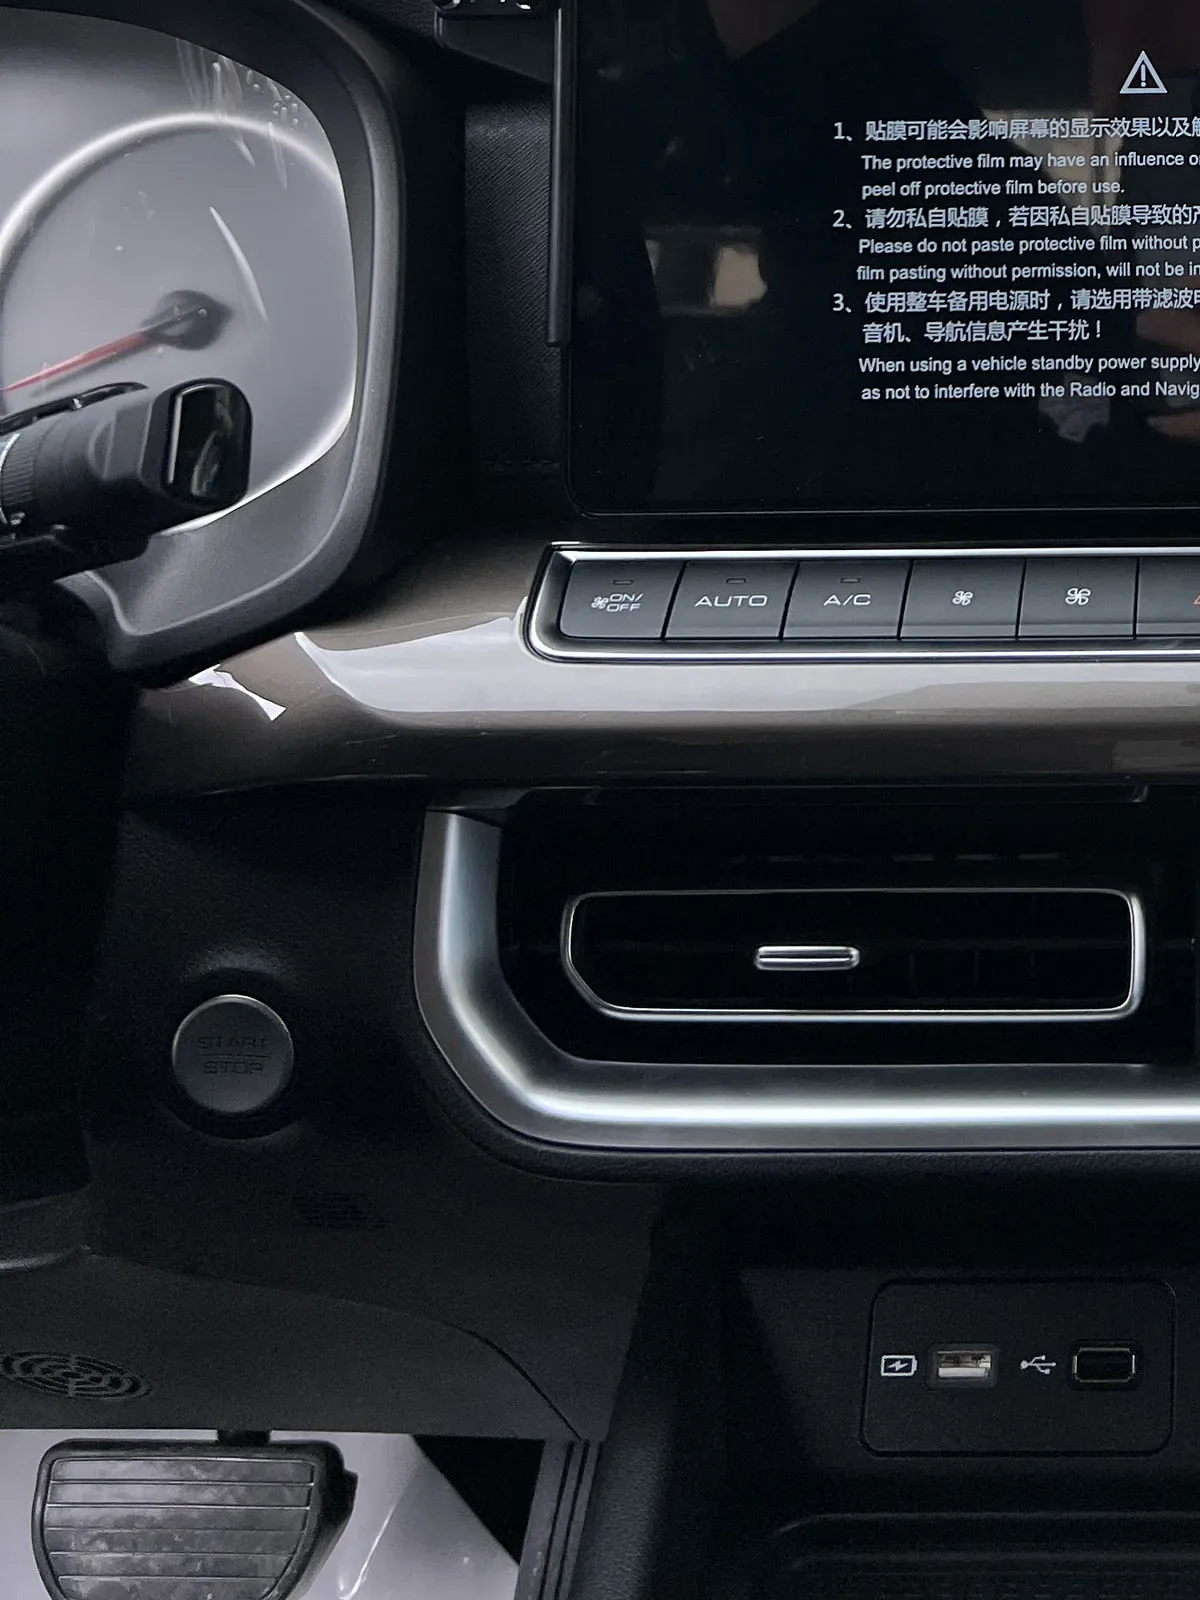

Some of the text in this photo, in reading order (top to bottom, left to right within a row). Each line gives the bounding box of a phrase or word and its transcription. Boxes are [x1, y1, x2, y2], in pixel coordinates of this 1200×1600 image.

[860, 153, 893, 170] The
[895, 153, 974, 173] protective
[976, 152, 1006, 169] film
[1008, 155, 1044, 172] may
[1047, 152, 1086, 168] have
[1089, 150, 1111, 167] an
[1114, 151, 1185, 168] influence
[861, 178, 1125, 200] peel off protective film before use.
[858, 237, 914, 254] Please
[916, 237, 938, 254] do
[941, 237, 968, 254] not
[970, 236, 1015, 256] paste
[1018, 235, 1096, 256] protective
[1099, 234, 1128, 251] film
[1131, 234, 1189, 251] without
[855, 265, 885, 282] film
[888, 264, 947, 284] pasting
[949, 262, 1008, 279] without
[1011, 262, 1102, 282] permission,
[1105, 260, 1132, 277] will
[1135, 261, 1161, 278] not
[1164, 260, 1185, 277] be
[857, 356, 906, 373] When
[909, 356, 953, 376] using
[956, 359, 968, 373] a
[970, 354, 1028, 372] vehicle
[1031, 354, 1095, 375] standby
[1097, 356, 1148, 374] power
[860, 386, 881, 400] as
[884, 384, 911, 400] not
[913, 384, 931, 400] to
[933, 382, 1000, 400] interfere
[1003, 382, 1036, 399] with
[1039, 381, 1066, 399] the
[1069, 379, 1117, 398] Radio
[1120, 380, 1151, 397] and
[609, 593, 644, 602] ON/
[694, 594, 768, 608] AUTO
[823, 594, 872, 607] A/C
[606, 603, 641, 613] OFF
[198, 1035, 268, 1050] START
[203, 1060, 264, 1075] STOP
